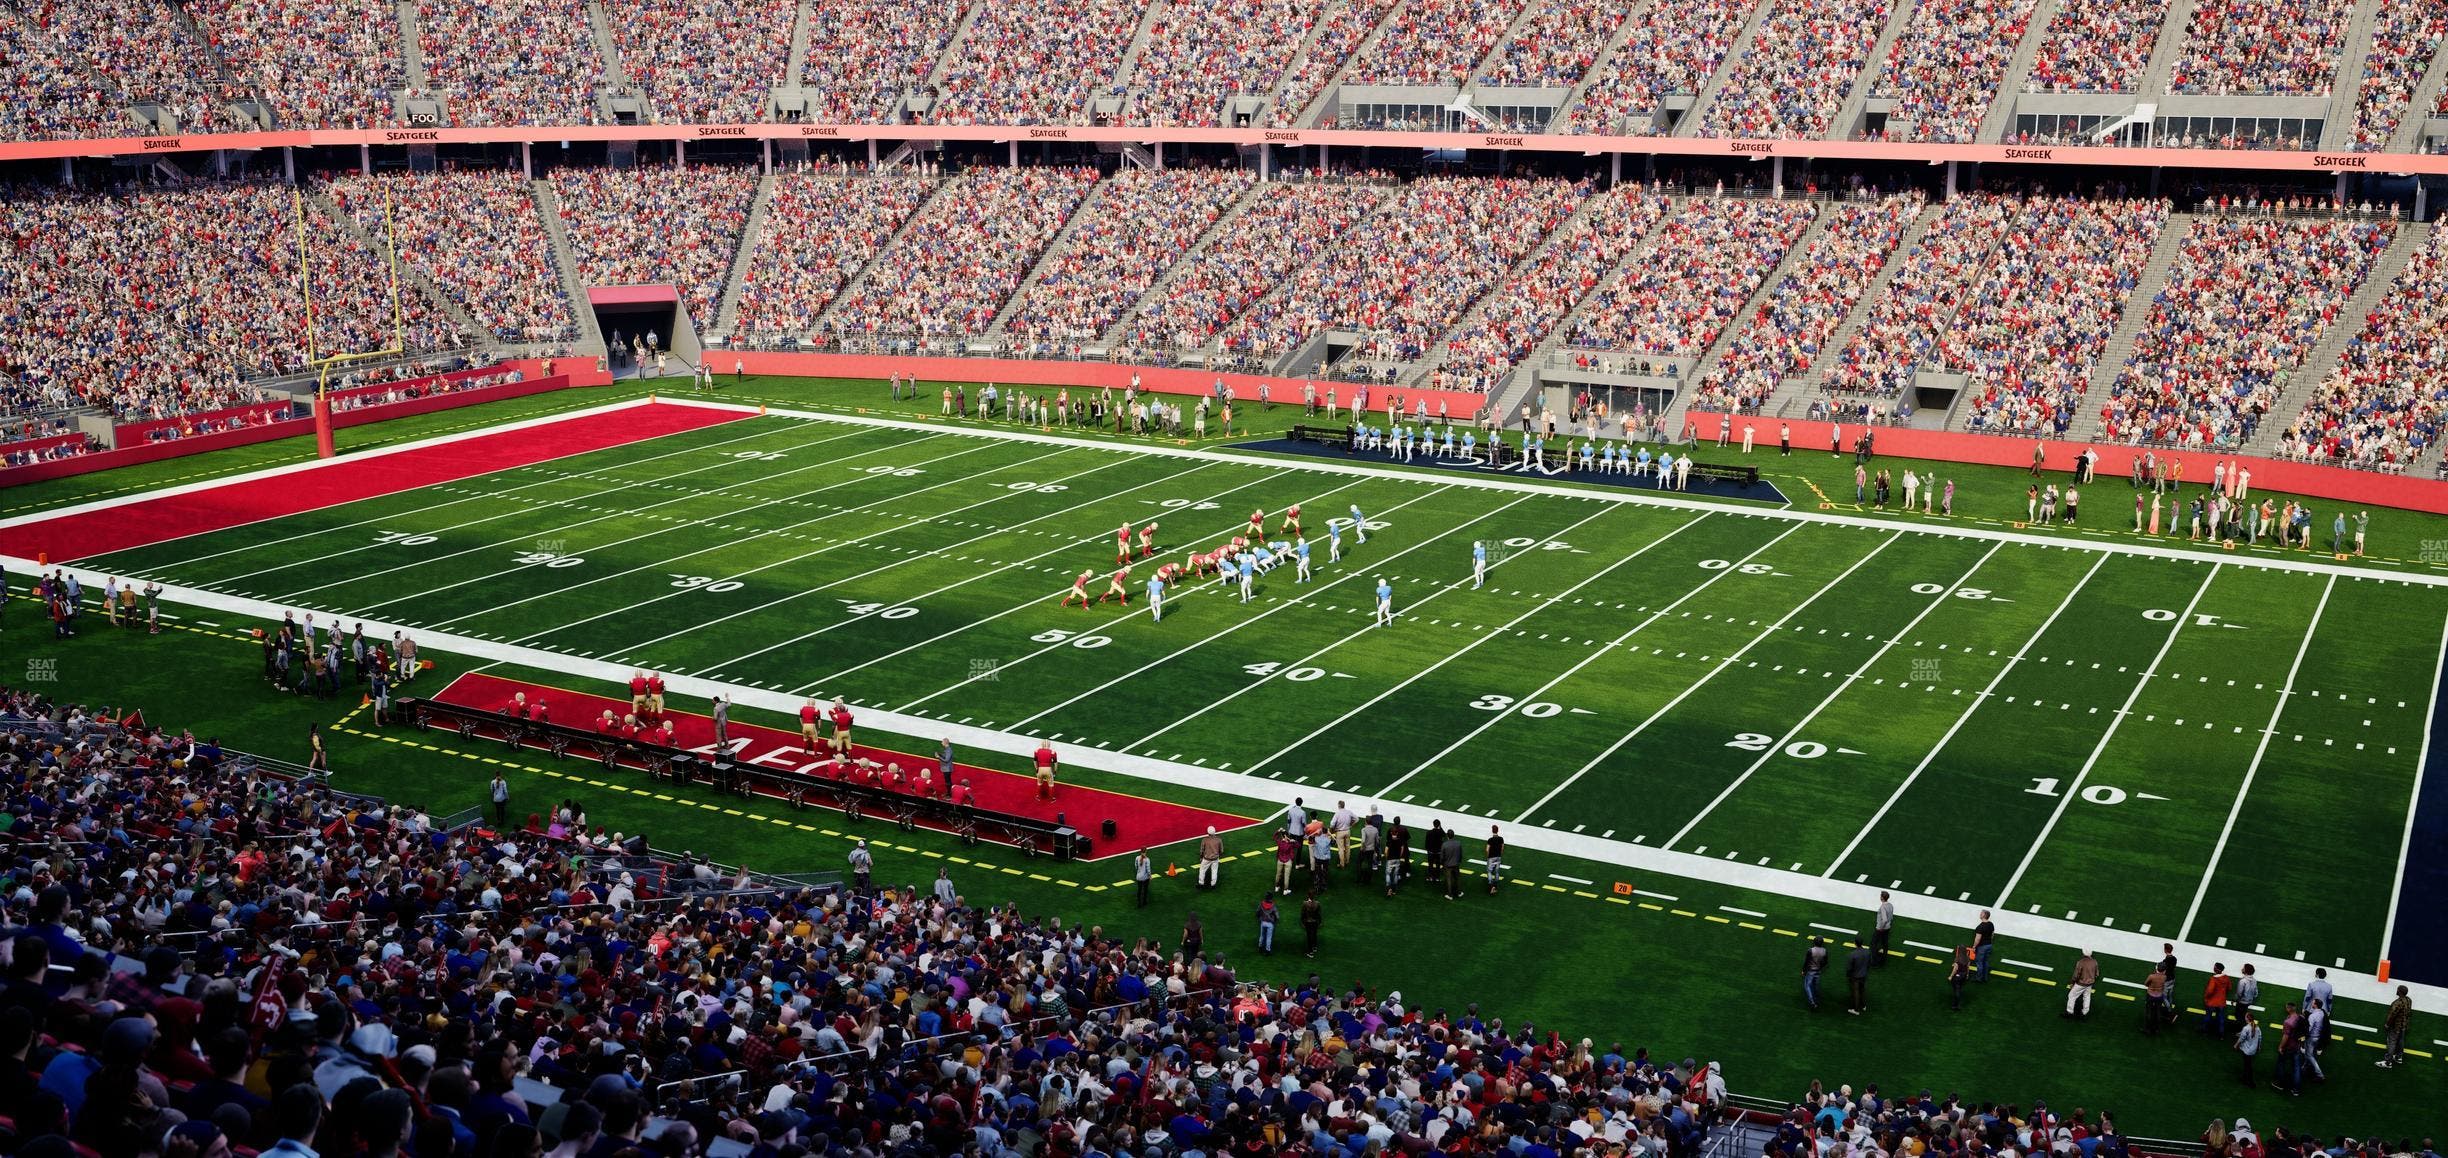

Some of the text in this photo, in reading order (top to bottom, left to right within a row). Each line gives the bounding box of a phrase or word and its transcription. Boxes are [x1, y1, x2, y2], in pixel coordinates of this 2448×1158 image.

[386, 131, 438, 141] SEATGEEK
[698, 127, 746, 136] SEATGEEK
[801, 127, 838, 136] SEATGEEK
[1030, 129, 1067, 138] SEATGEEK
[1265, 131, 1298, 141] SEATGEEK
[143, 139, 181, 150] SEATGEEK
[1486, 137, 1523, 146] SEATGEEK
[1731, 142, 1772, 152] SEATGEEK
[2005, 148, 2052, 160] SEATGEEK
[2313, 156, 2367, 168] SEATGEEK
